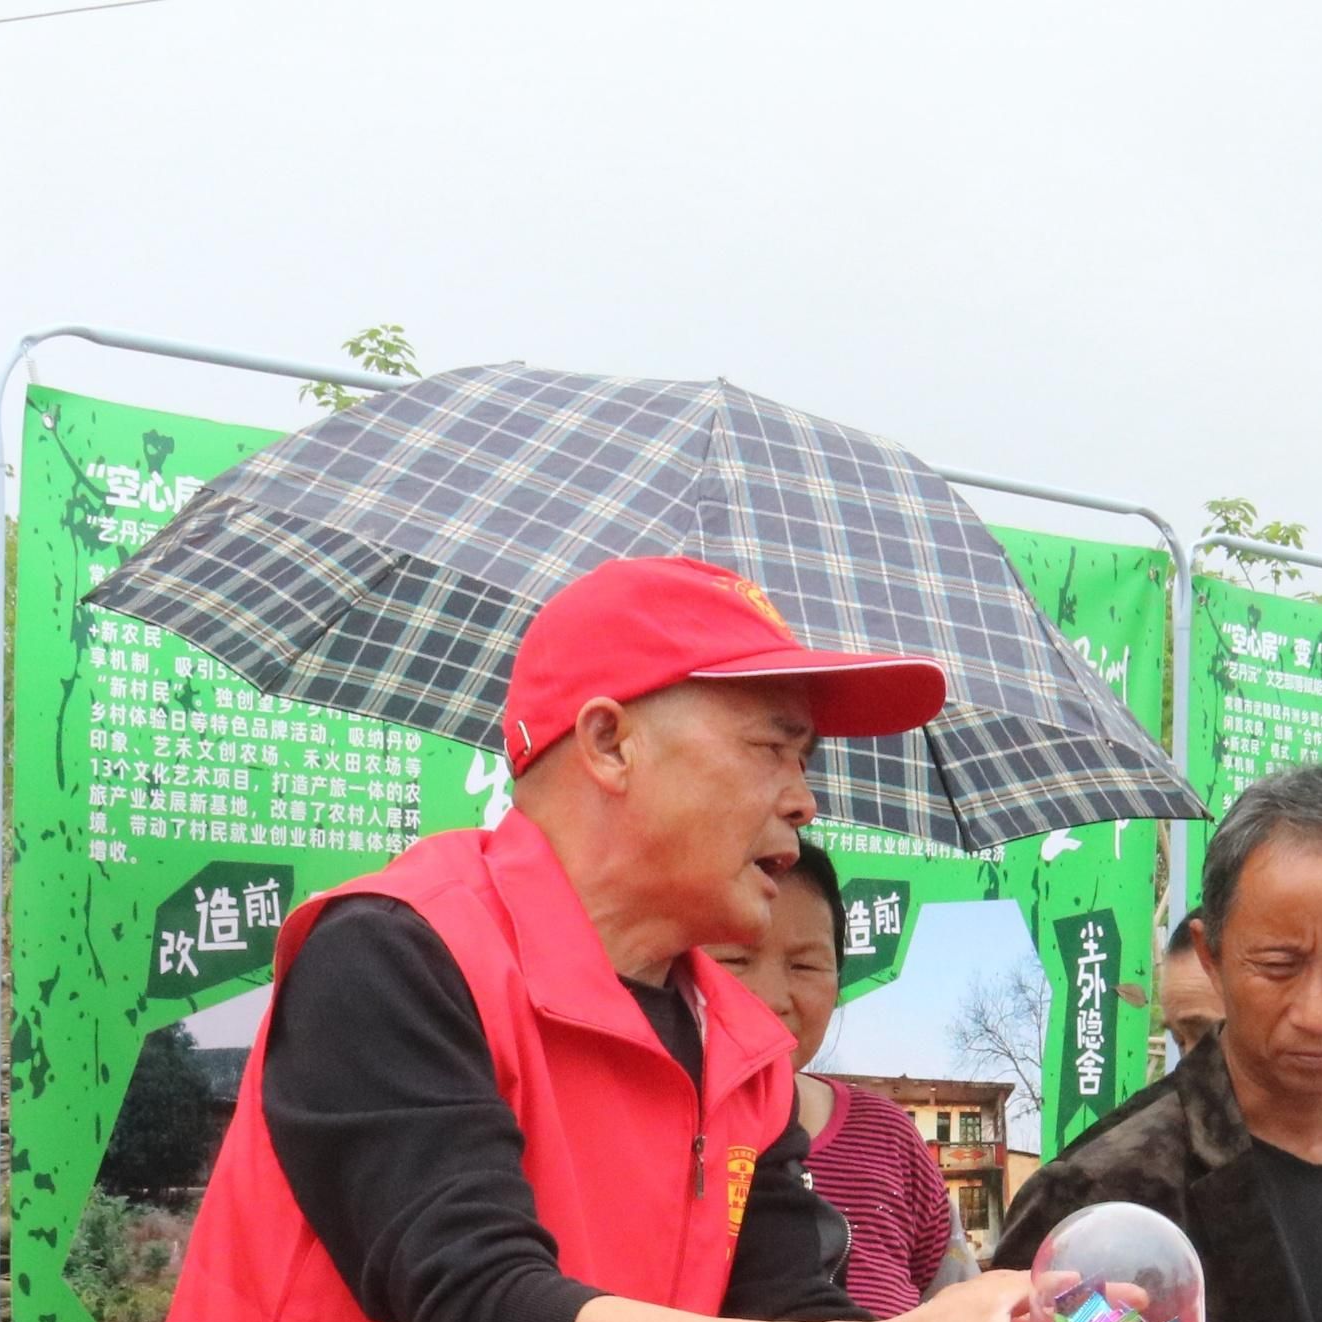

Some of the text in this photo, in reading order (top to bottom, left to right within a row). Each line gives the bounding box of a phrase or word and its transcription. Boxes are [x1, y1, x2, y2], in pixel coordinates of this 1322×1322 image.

[159, 877, 282, 977] 改造前
[1075, 921, 1108, 1095] 尘外隐舍
